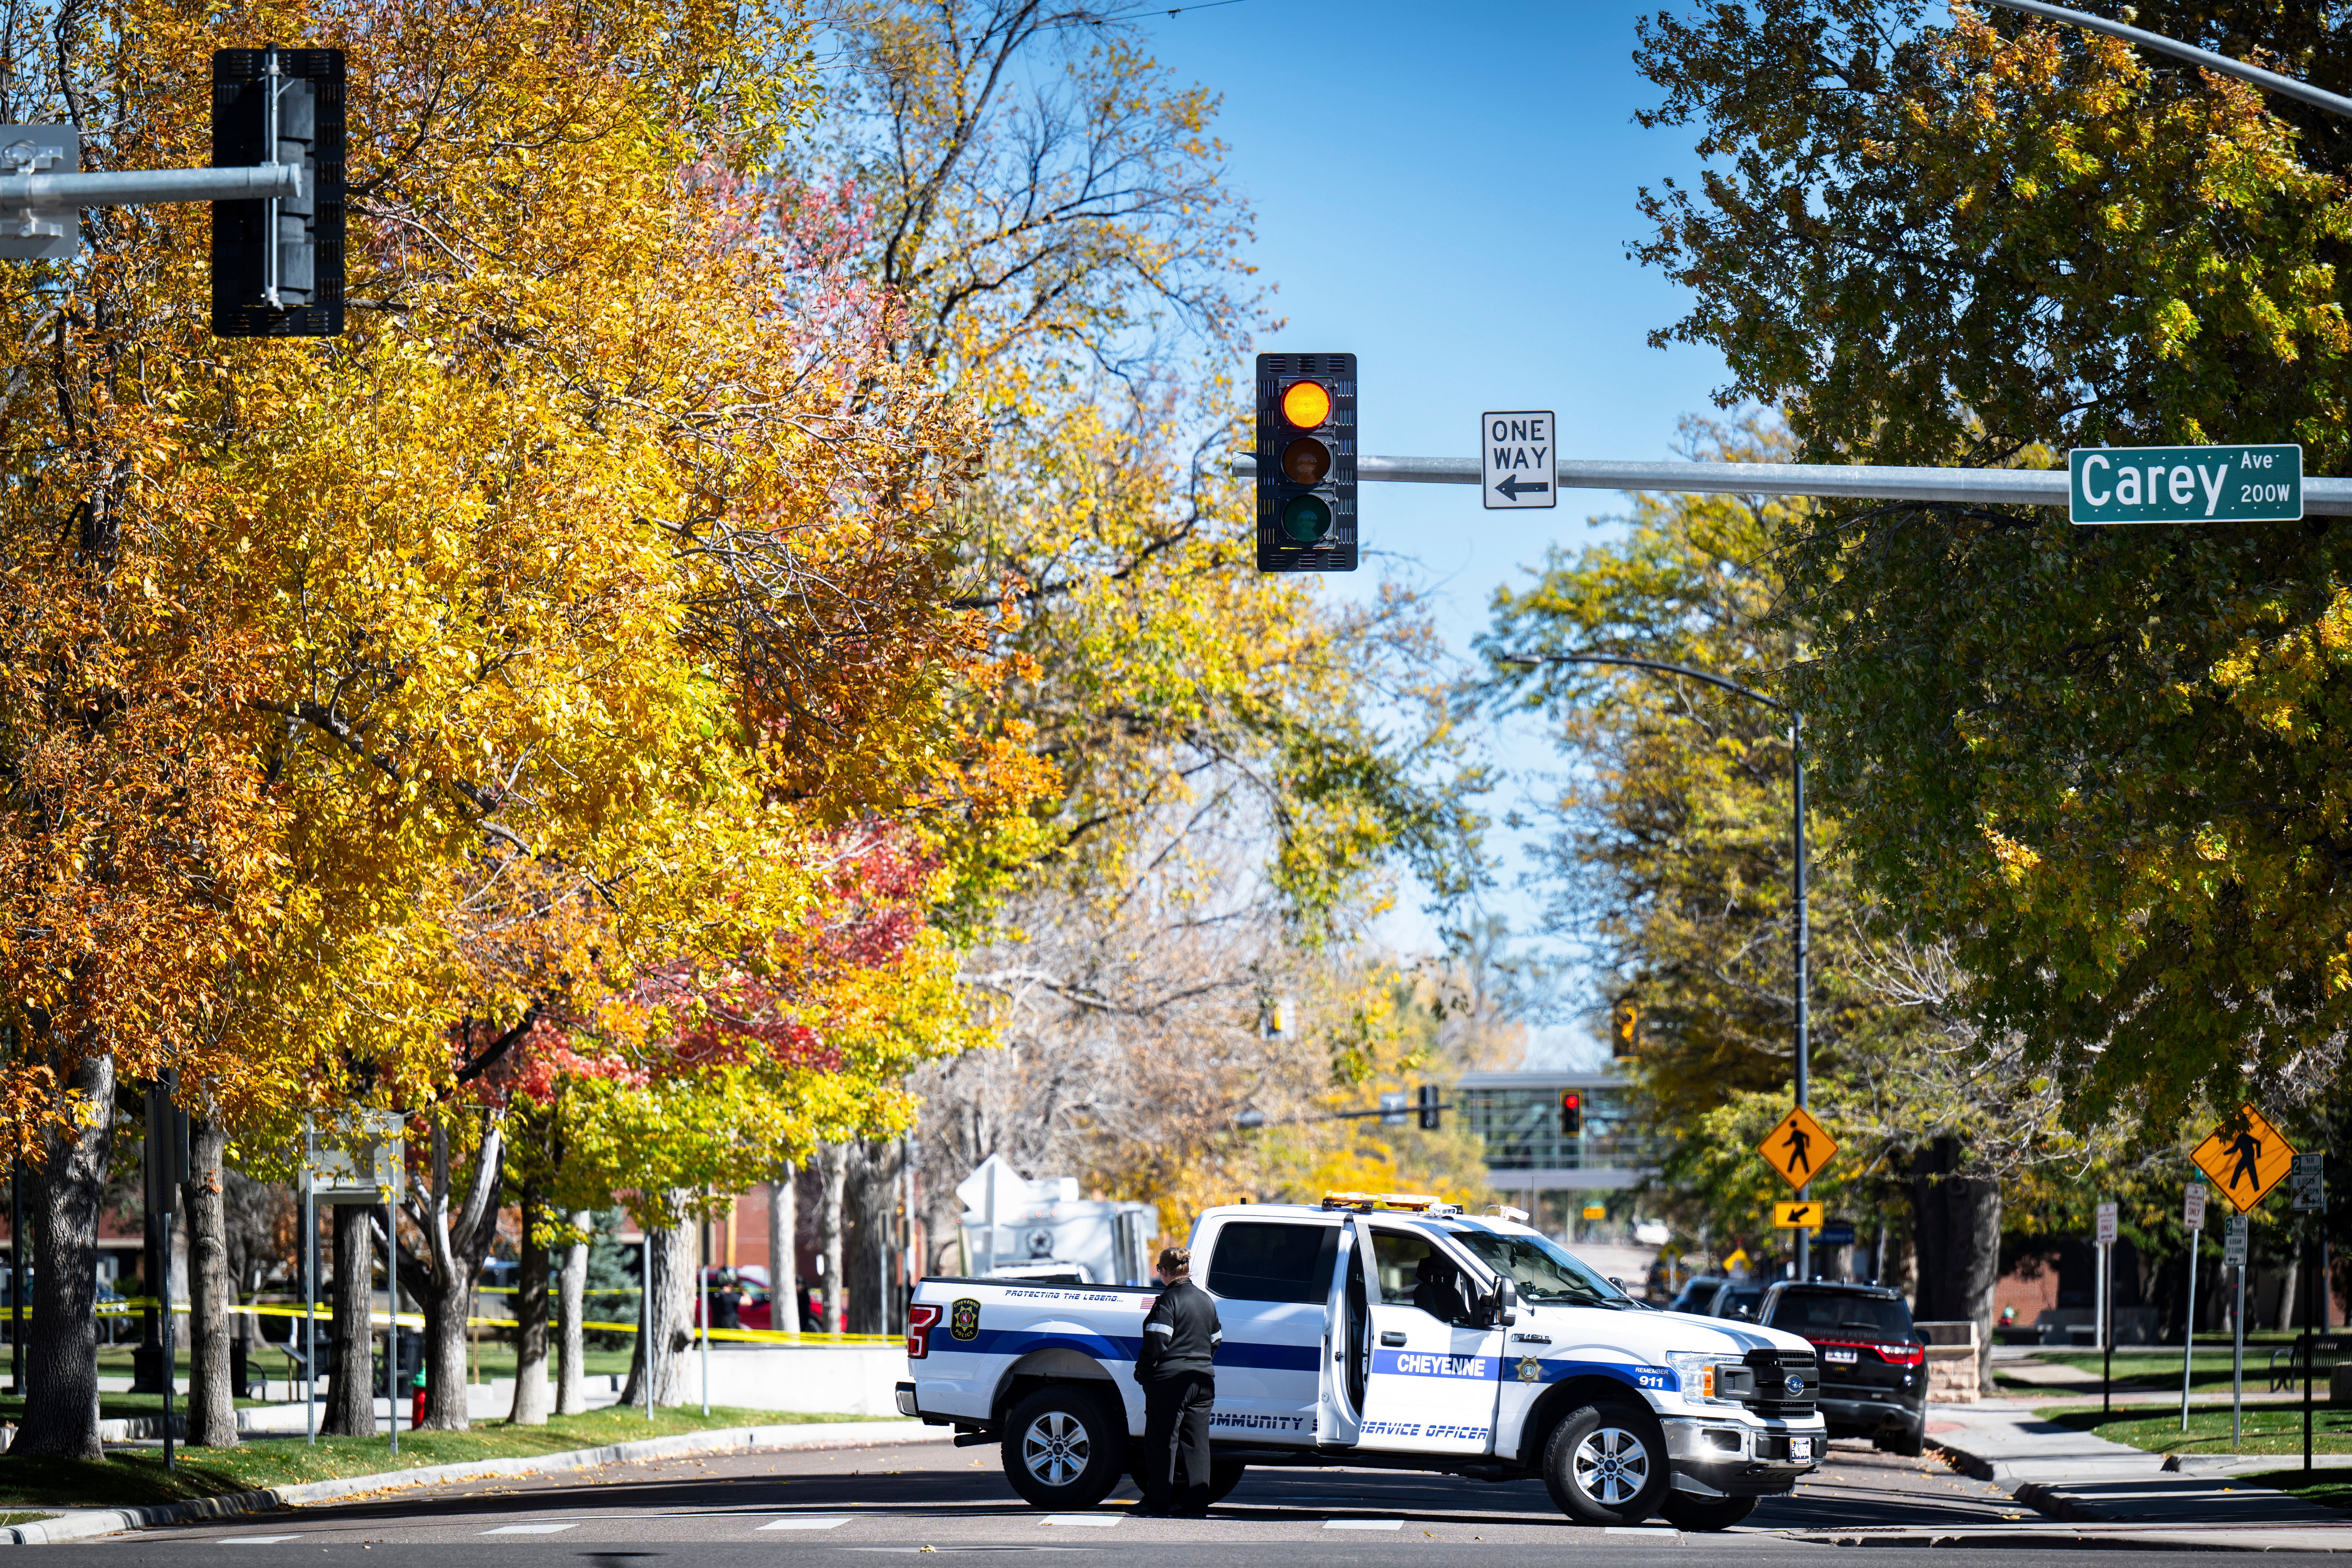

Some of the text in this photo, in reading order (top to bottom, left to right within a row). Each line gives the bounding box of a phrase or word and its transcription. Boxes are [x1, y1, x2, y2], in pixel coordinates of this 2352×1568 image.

[1492, 420, 1544, 441] ONE
[1493, 447, 1547, 469] WAY
[2082, 451, 2272, 516] Carey Ave
[2240, 484, 2290, 502] 200W
[2293, 1159, 2299, 1173] 2
[2188, 1208, 2200, 1216] ONLY
[2100, 1224, 2112, 1233] ONLY
[2226, 1221, 2231, 1233] 2
[1005, 1290, 1060, 1299] PROTECTING
[954, 1300, 979, 1309] CHEYENNE
[955, 1329, 973, 1338] POLICE
[1804, 1327, 1879, 1340] HIGHWAY PATROL
[1397, 1354, 1485, 1377] CHEYENNE
[1639, 1375, 1663, 1387] 911
[1209, 1413, 1303, 1430] OMMUNITY
[1360, 1421, 1488, 1440] SERVICE OFFICER
